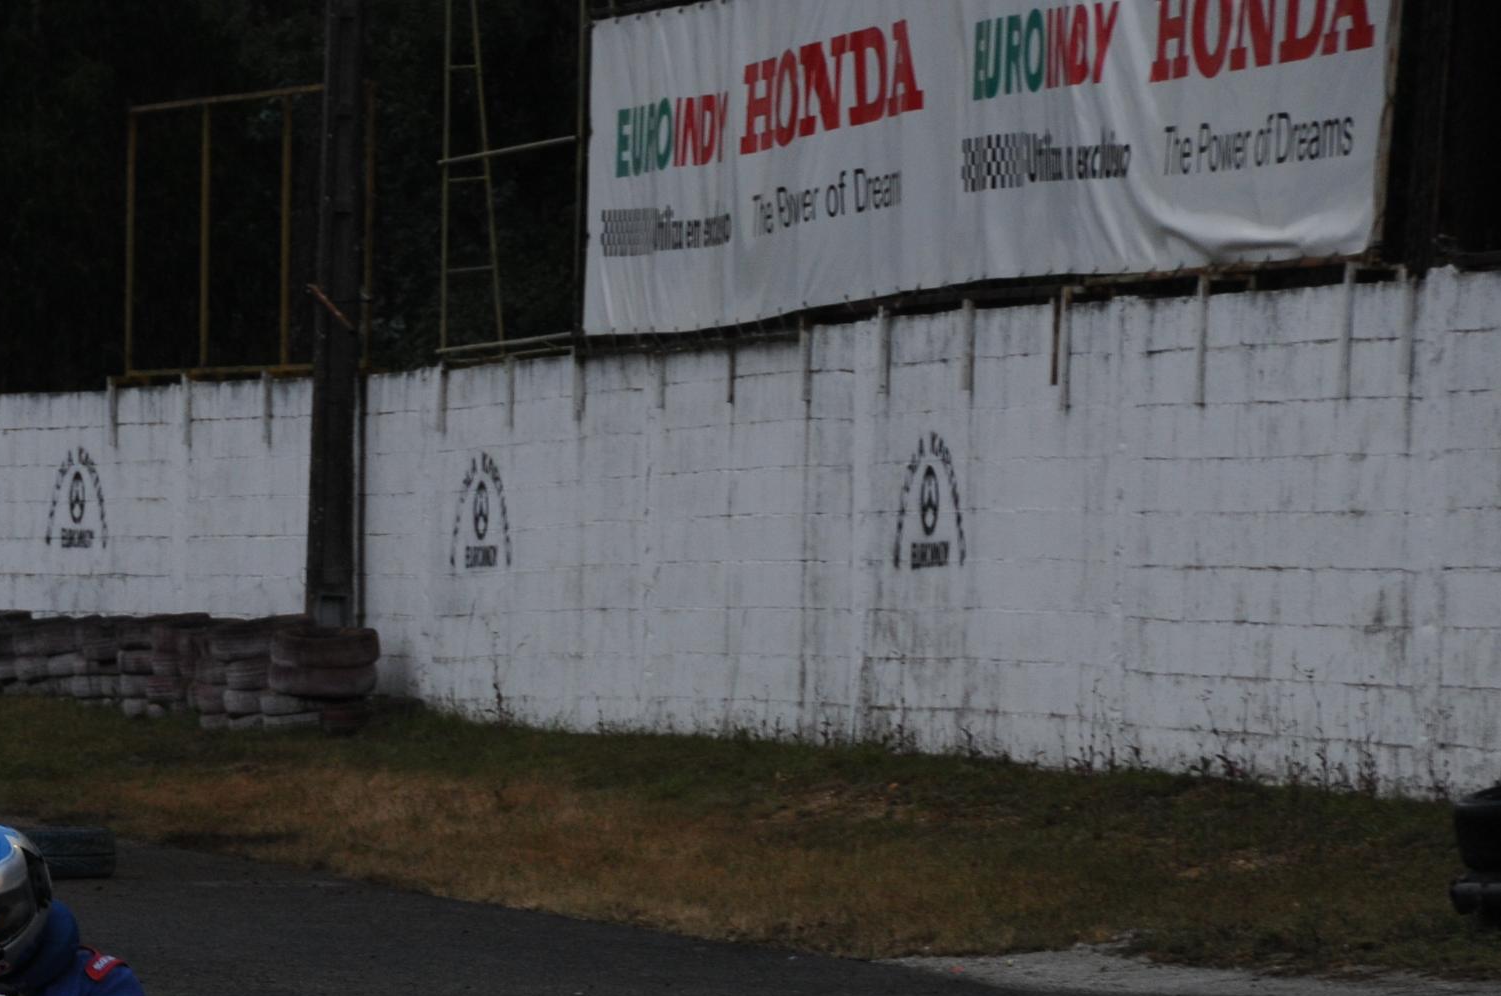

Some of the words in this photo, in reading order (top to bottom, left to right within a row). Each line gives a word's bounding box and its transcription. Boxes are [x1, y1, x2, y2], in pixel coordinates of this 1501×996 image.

[740, 20, 924, 155] HONDA
[973, 1, 1120, 100] EUROINDY
[1149, 0, 1376, 84] HONDA
[1196, 122, 1252, 173] Power
[1275, 112, 1355, 164] Dreams
[825, 170, 847, 217] of
